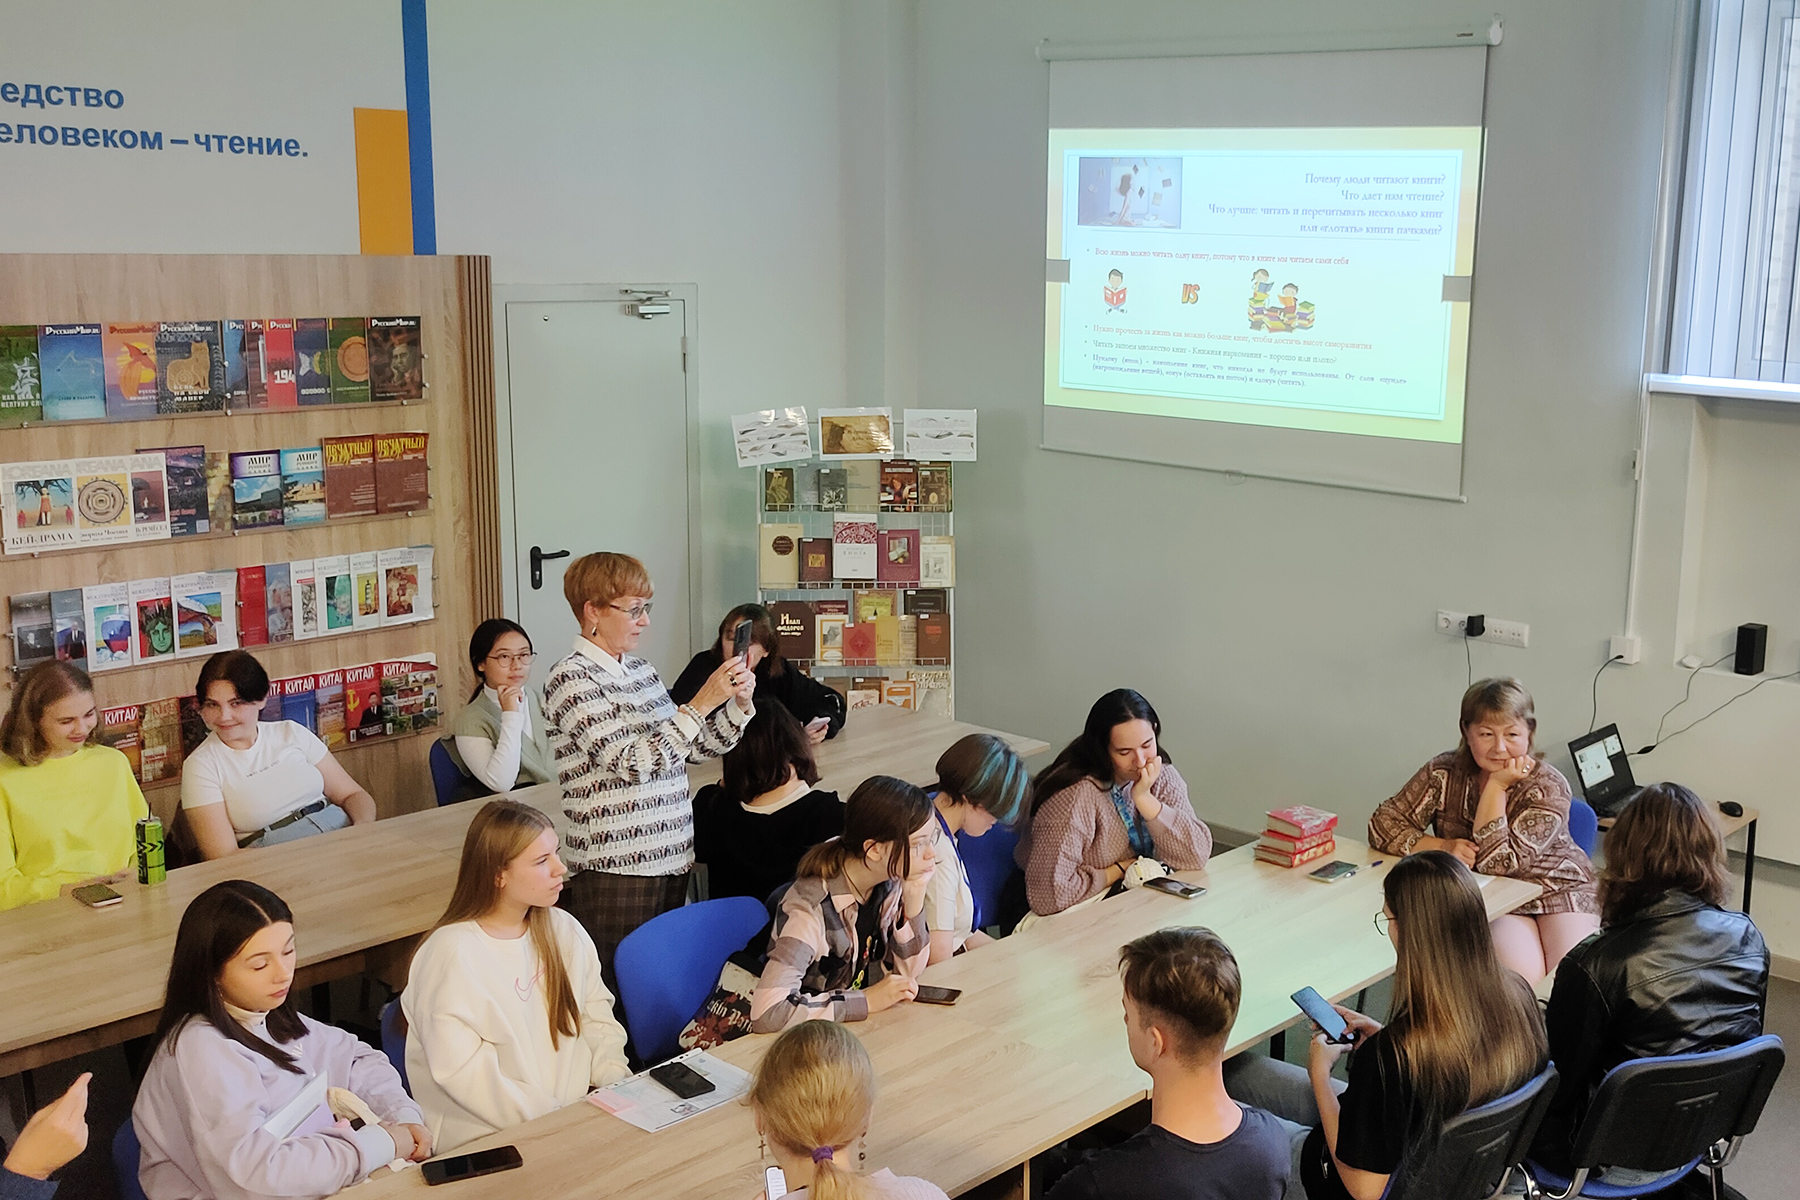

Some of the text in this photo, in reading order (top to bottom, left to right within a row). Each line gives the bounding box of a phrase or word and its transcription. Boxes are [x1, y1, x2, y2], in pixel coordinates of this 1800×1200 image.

[1, 82, 124, 109] едство
[194, 132, 309, 158] чтение.
[1305, 173, 1446, 187] Почему люди читают книги?
[1341, 190, 1444, 202] Что дает нам чтение?
[1208, 203, 1226, 214] Что
[1227, 207, 1258, 218] лучше:
[1260, 208, 1290, 216] читать
[1302, 208, 1366, 219] перечитывать
[1368, 210, 1418, 218] несколько
[1420, 210, 1444, 218] книг
[1366, 226, 1394, 234] книги
[1396, 224, 1442, 236] пачками?
[1095, 248, 1108, 256] Всю
[1174, 252, 1190, 262] одну
[1192, 253, 1212, 262] книгу,
[1212, 254, 1236, 263] потому
[1333, 256, 1349, 265] себя
[1093, 324, 1114, 334] Нужно
[1115, 328, 1143, 336] прочесть
[1206, 332, 1232, 341] больше
[1252, 336, 1273, 344] чтобы
[1324, 341, 1372, 350] саморазвития
[1092, 340, 1114, 348] Читать
[1138, 344, 1170, 352] множество
[1192, 347, 1222, 356] Книжная
[1222, 351, 1262, 360] наркомания
[1269, 354, 1296, 362] хорошо
[1270, 368, 1288, 376] будут
[1344, 372, 1355, 381] От
[346, 666, 374, 684] КИТАЙ
[383, 662, 413, 677] КИТАЙ
[285, 676, 315, 694] КИТАЙ
[104, 706, 138, 726] КИТАЙ
